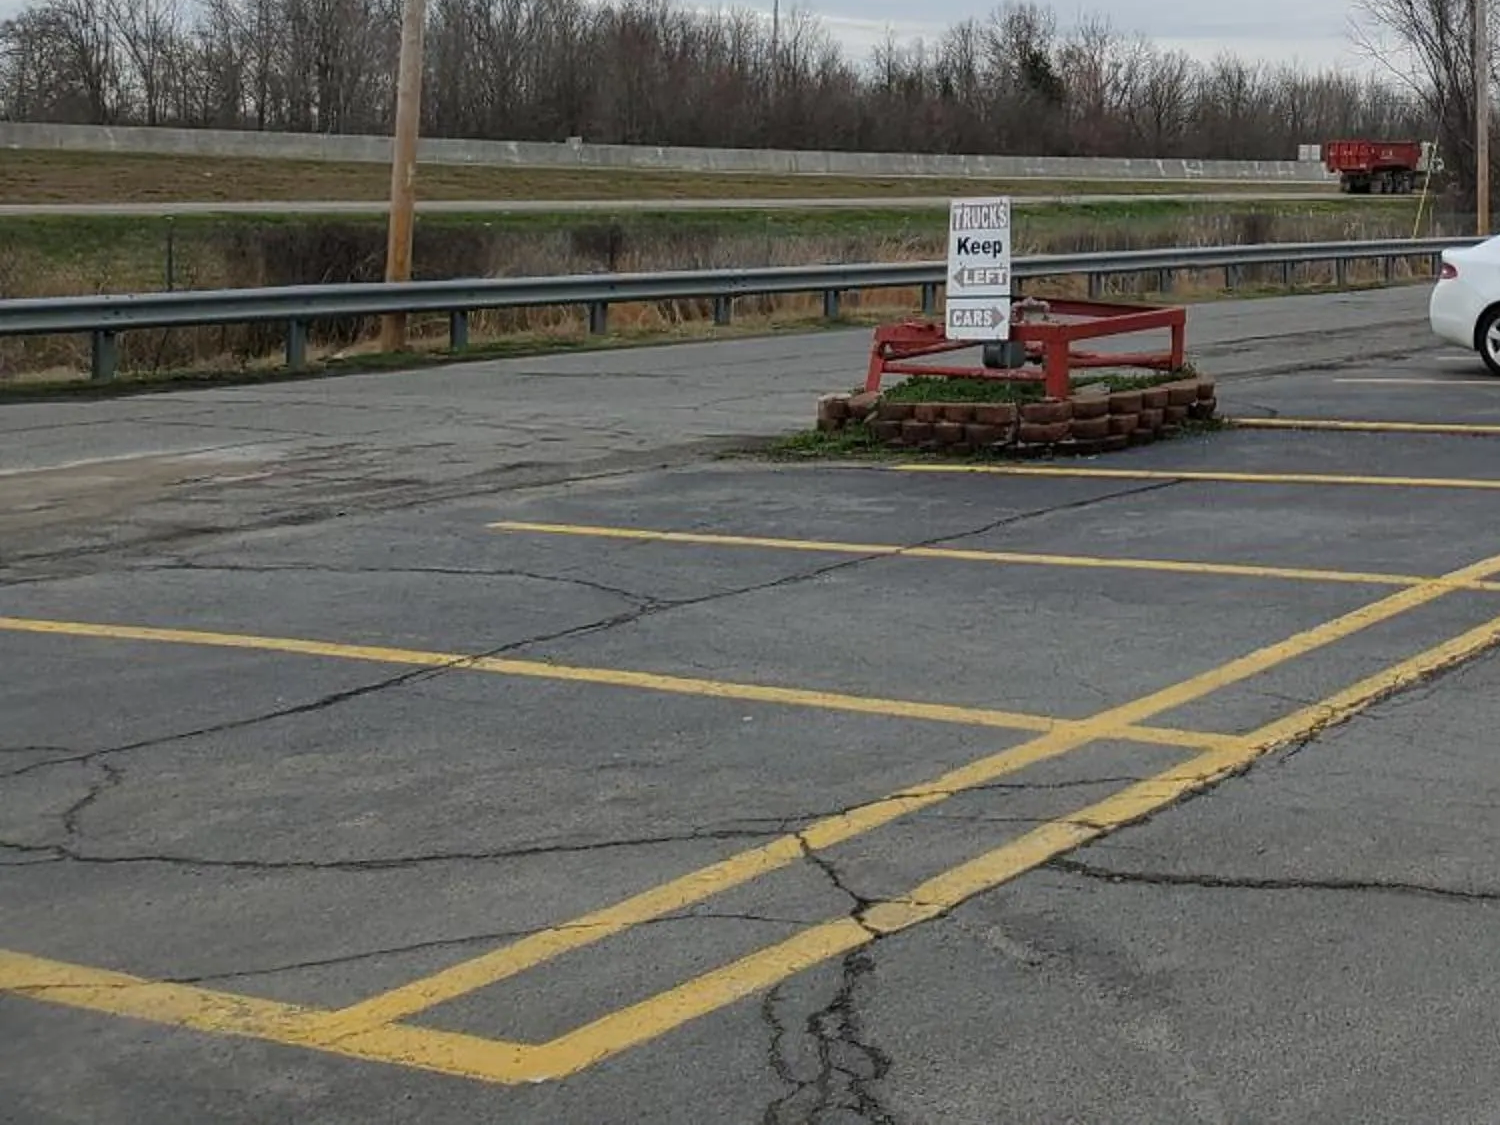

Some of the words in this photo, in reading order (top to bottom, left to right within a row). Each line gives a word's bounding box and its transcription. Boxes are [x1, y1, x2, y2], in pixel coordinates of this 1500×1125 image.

[953, 204, 1007, 230] TRUCKS
[957, 236, 1002, 258] Keep
[963, 269, 1007, 284] LEFT
[952, 310, 993, 326] CARS
